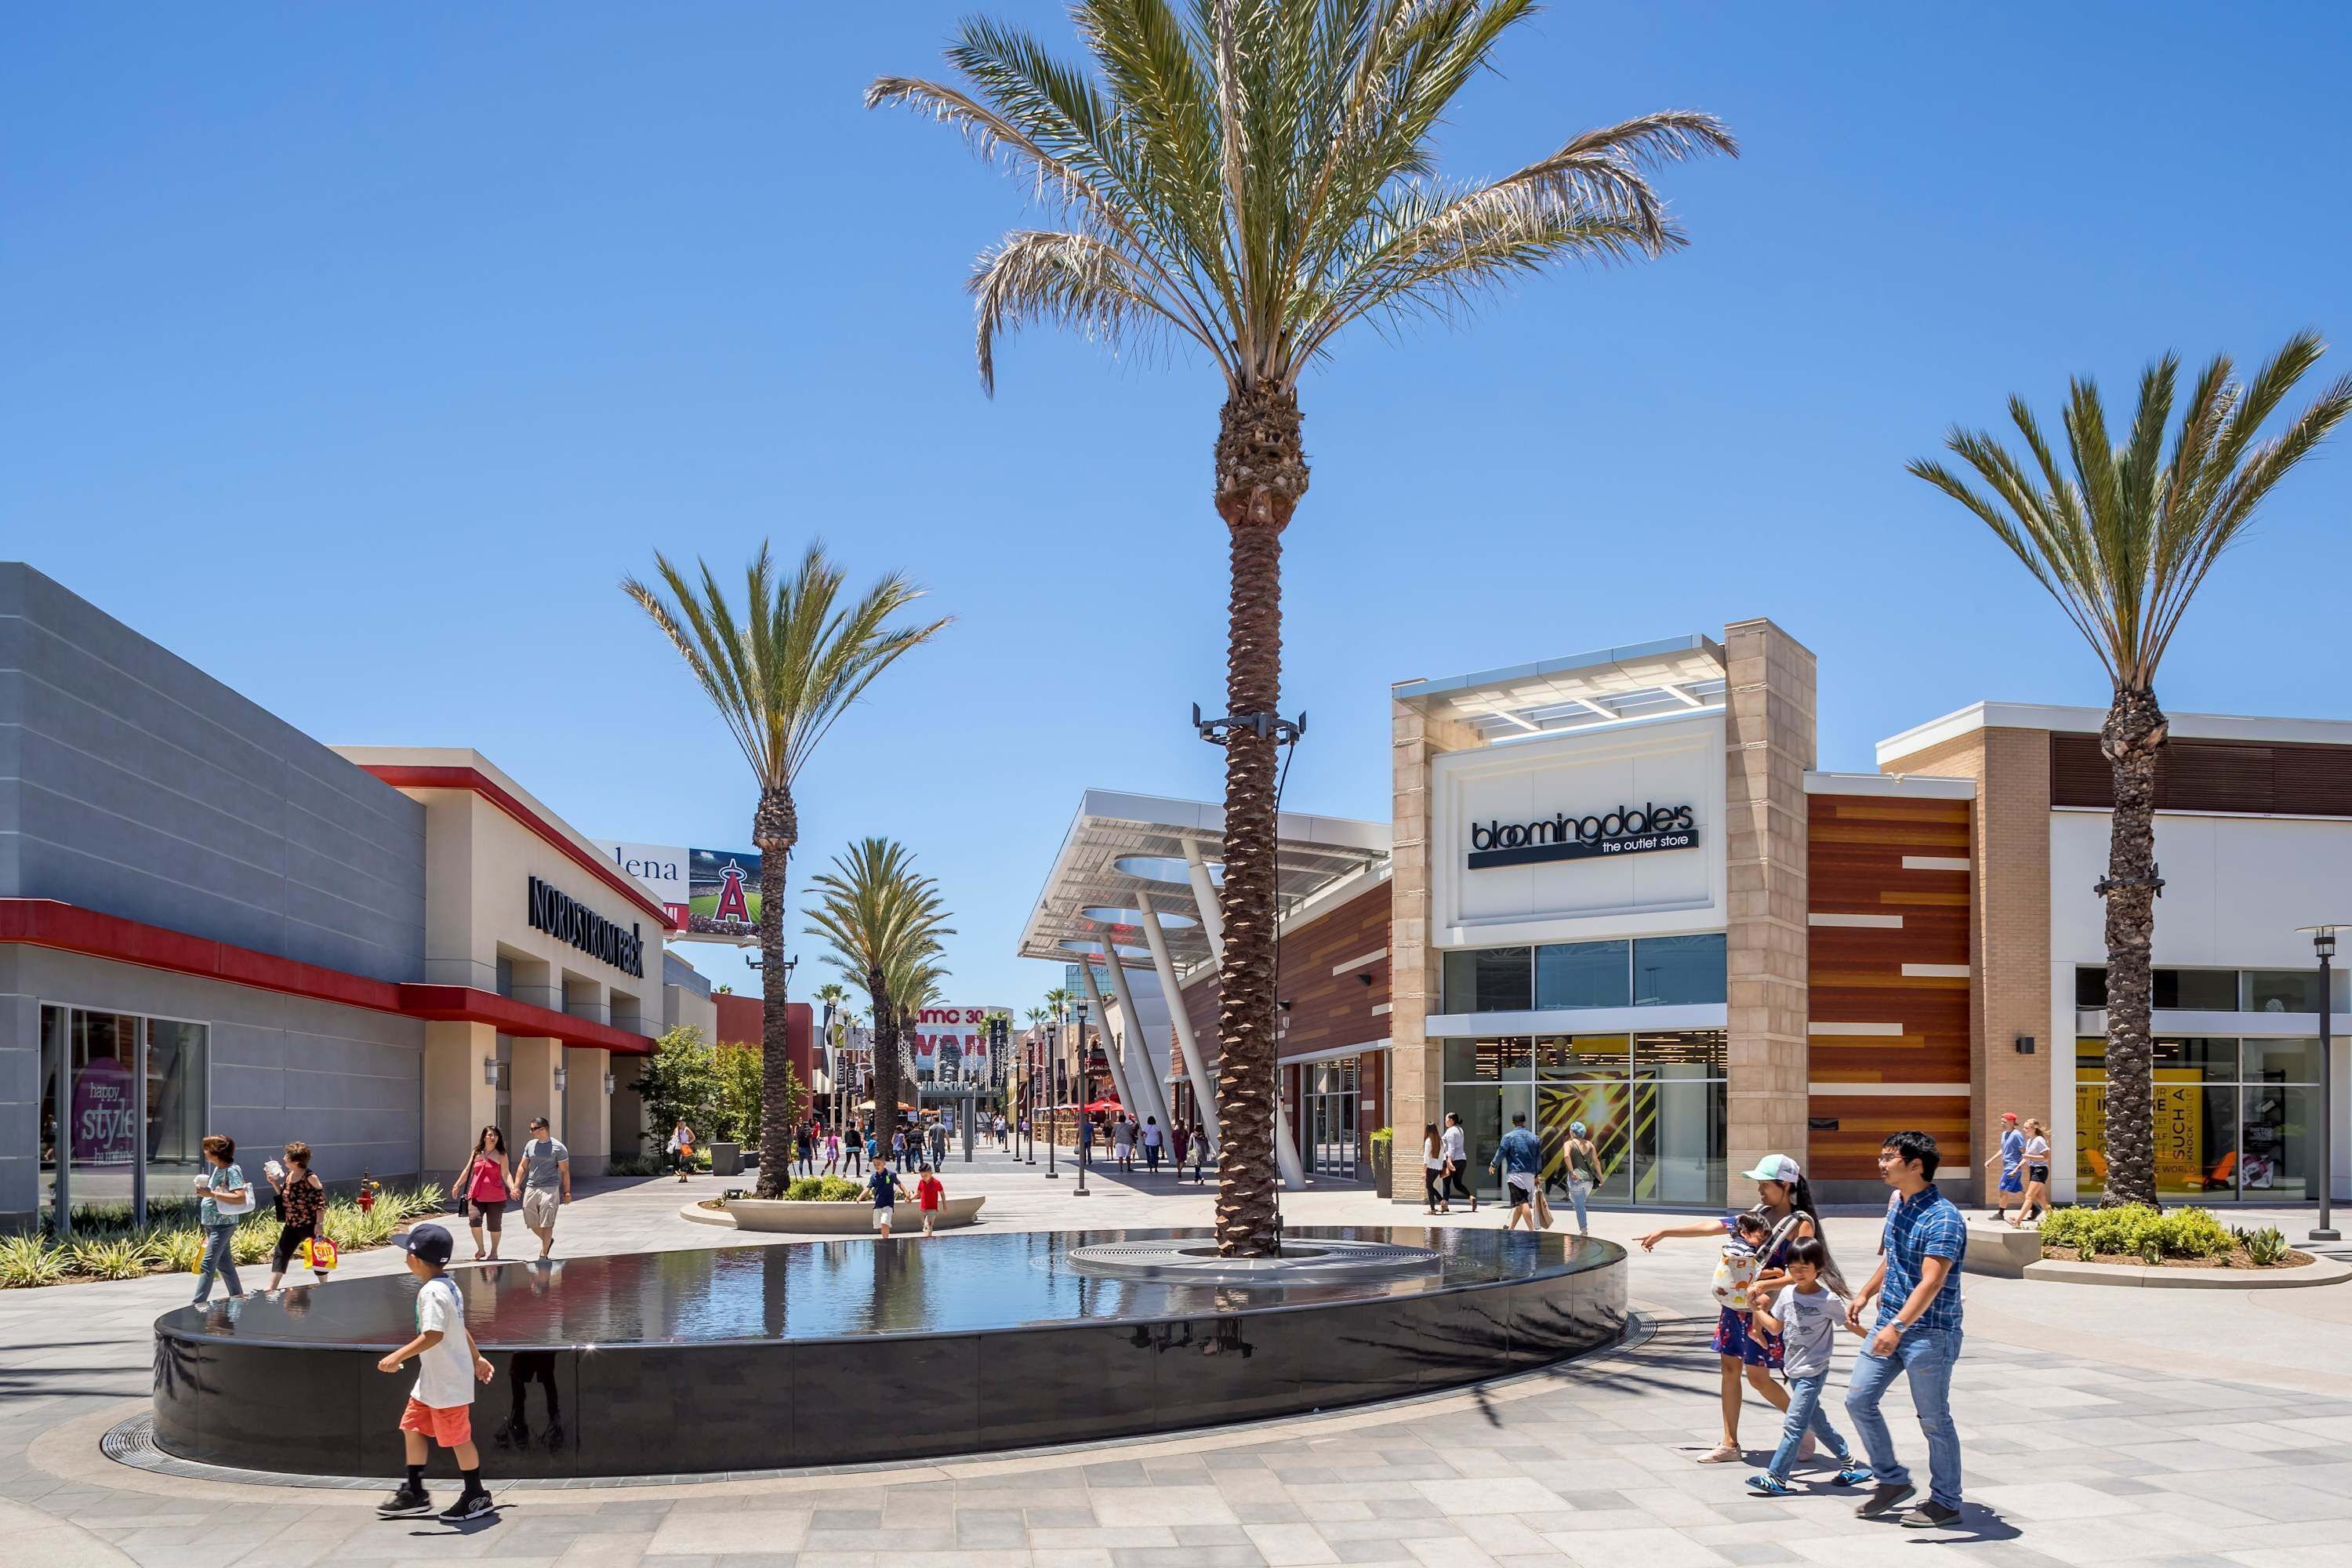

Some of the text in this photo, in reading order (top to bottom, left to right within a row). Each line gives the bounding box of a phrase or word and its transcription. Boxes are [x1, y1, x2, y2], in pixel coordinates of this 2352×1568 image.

[1602, 833, 1689, 853] the outlet store
[528, 876, 644, 978] NORDSTROM rack
[966, 1010, 984, 1024] 30
[90, 1082, 120, 1102] happy
[82, 1098, 134, 1149] style
[2172, 1088, 2185, 1160] SUCH A
[2163, 1165, 2196, 1174] WORLD
[318, 1247, 332, 1259] SALE
